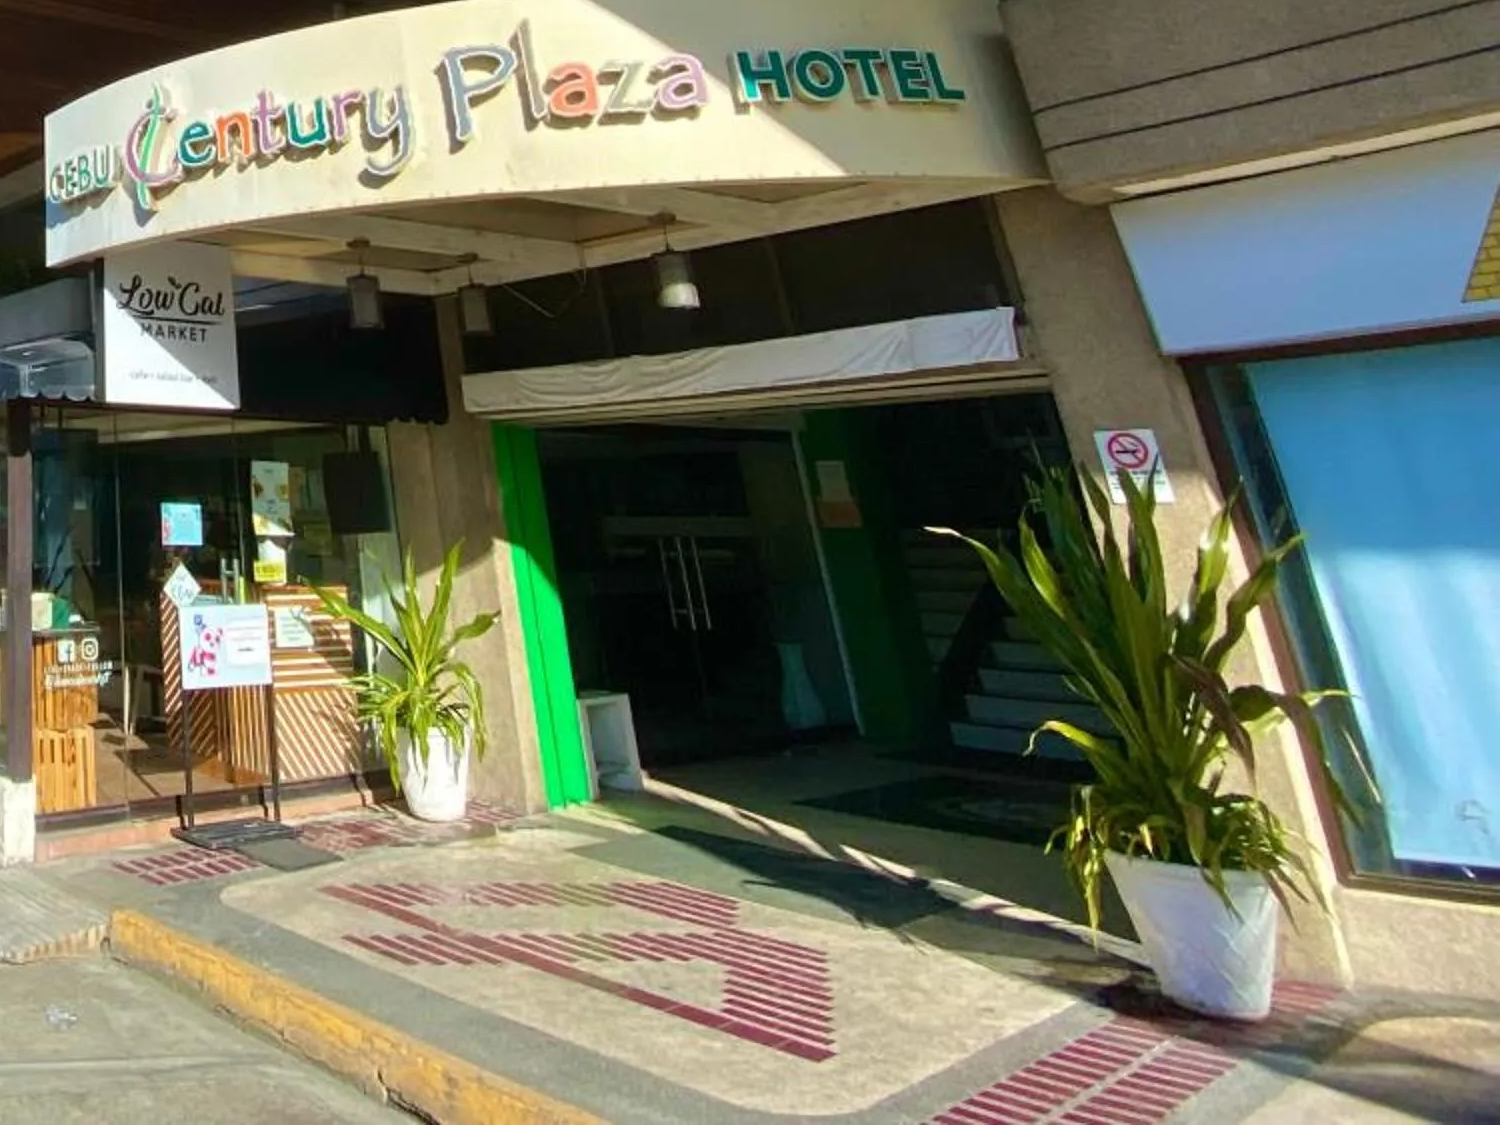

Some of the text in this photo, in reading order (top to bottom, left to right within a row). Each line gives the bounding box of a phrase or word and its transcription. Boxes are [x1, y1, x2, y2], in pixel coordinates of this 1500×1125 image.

[49, 17, 967, 210] CEBU Century Plaza HOTEL
[116, 275, 225, 316] Low Cal
[140, 322, 208, 342] MARKET
